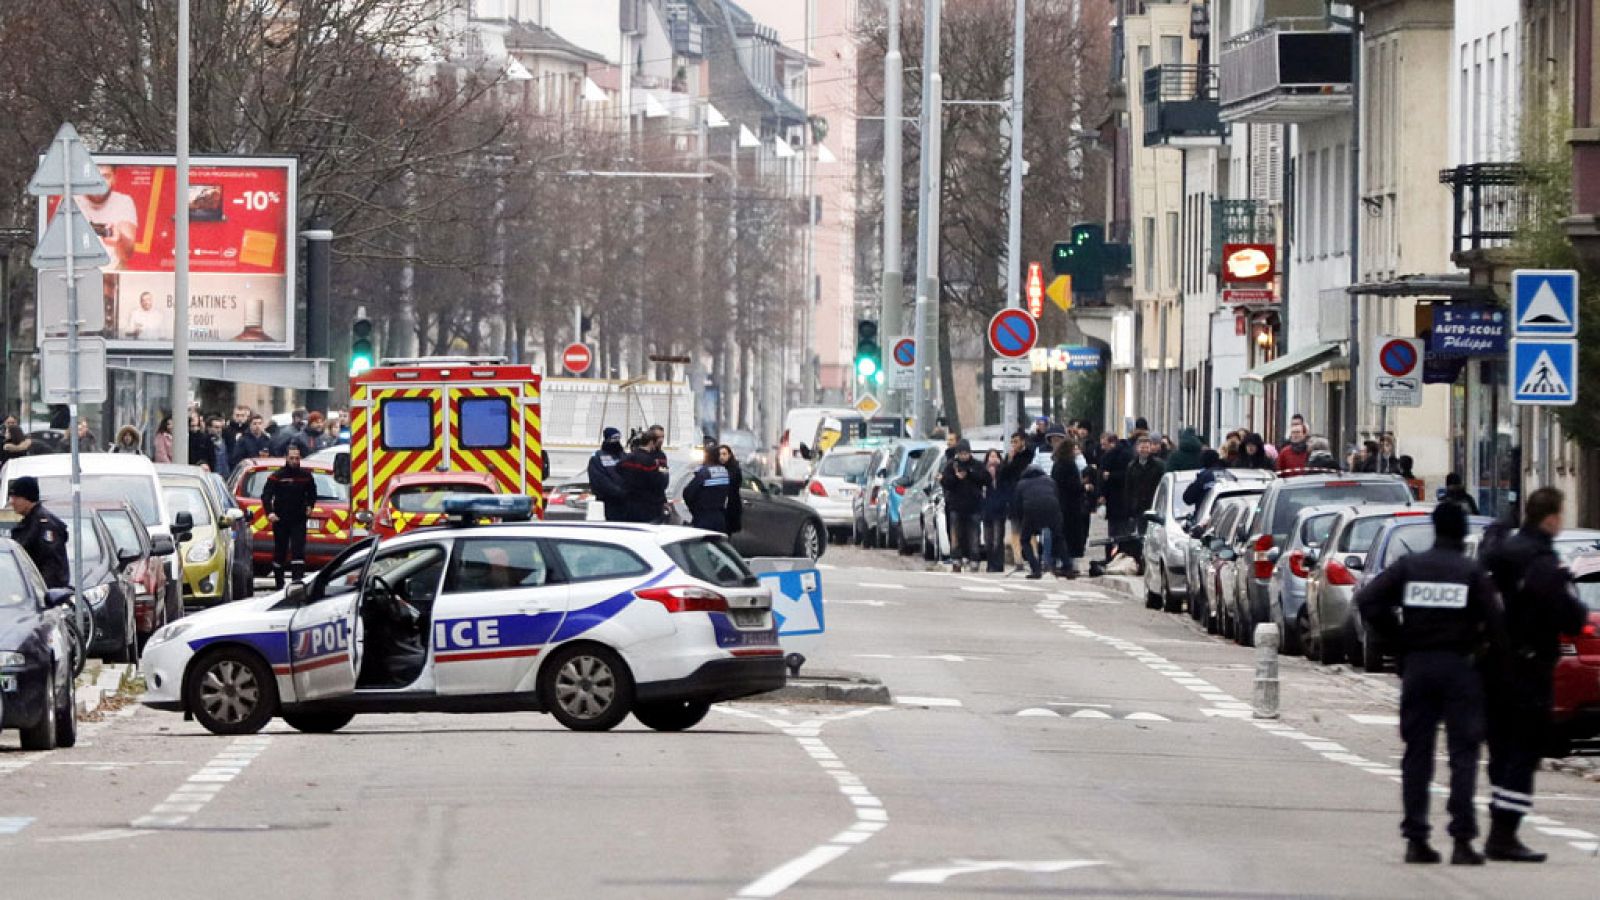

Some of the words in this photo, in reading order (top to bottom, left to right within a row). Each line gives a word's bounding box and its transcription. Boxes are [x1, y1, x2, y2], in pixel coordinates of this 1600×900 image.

[233, 191, 280, 211] -10%
[167, 295, 237, 309] BANTINE'S
[1443, 335, 1494, 350] Philippe
[1410, 585, 1465, 602] POLICE
